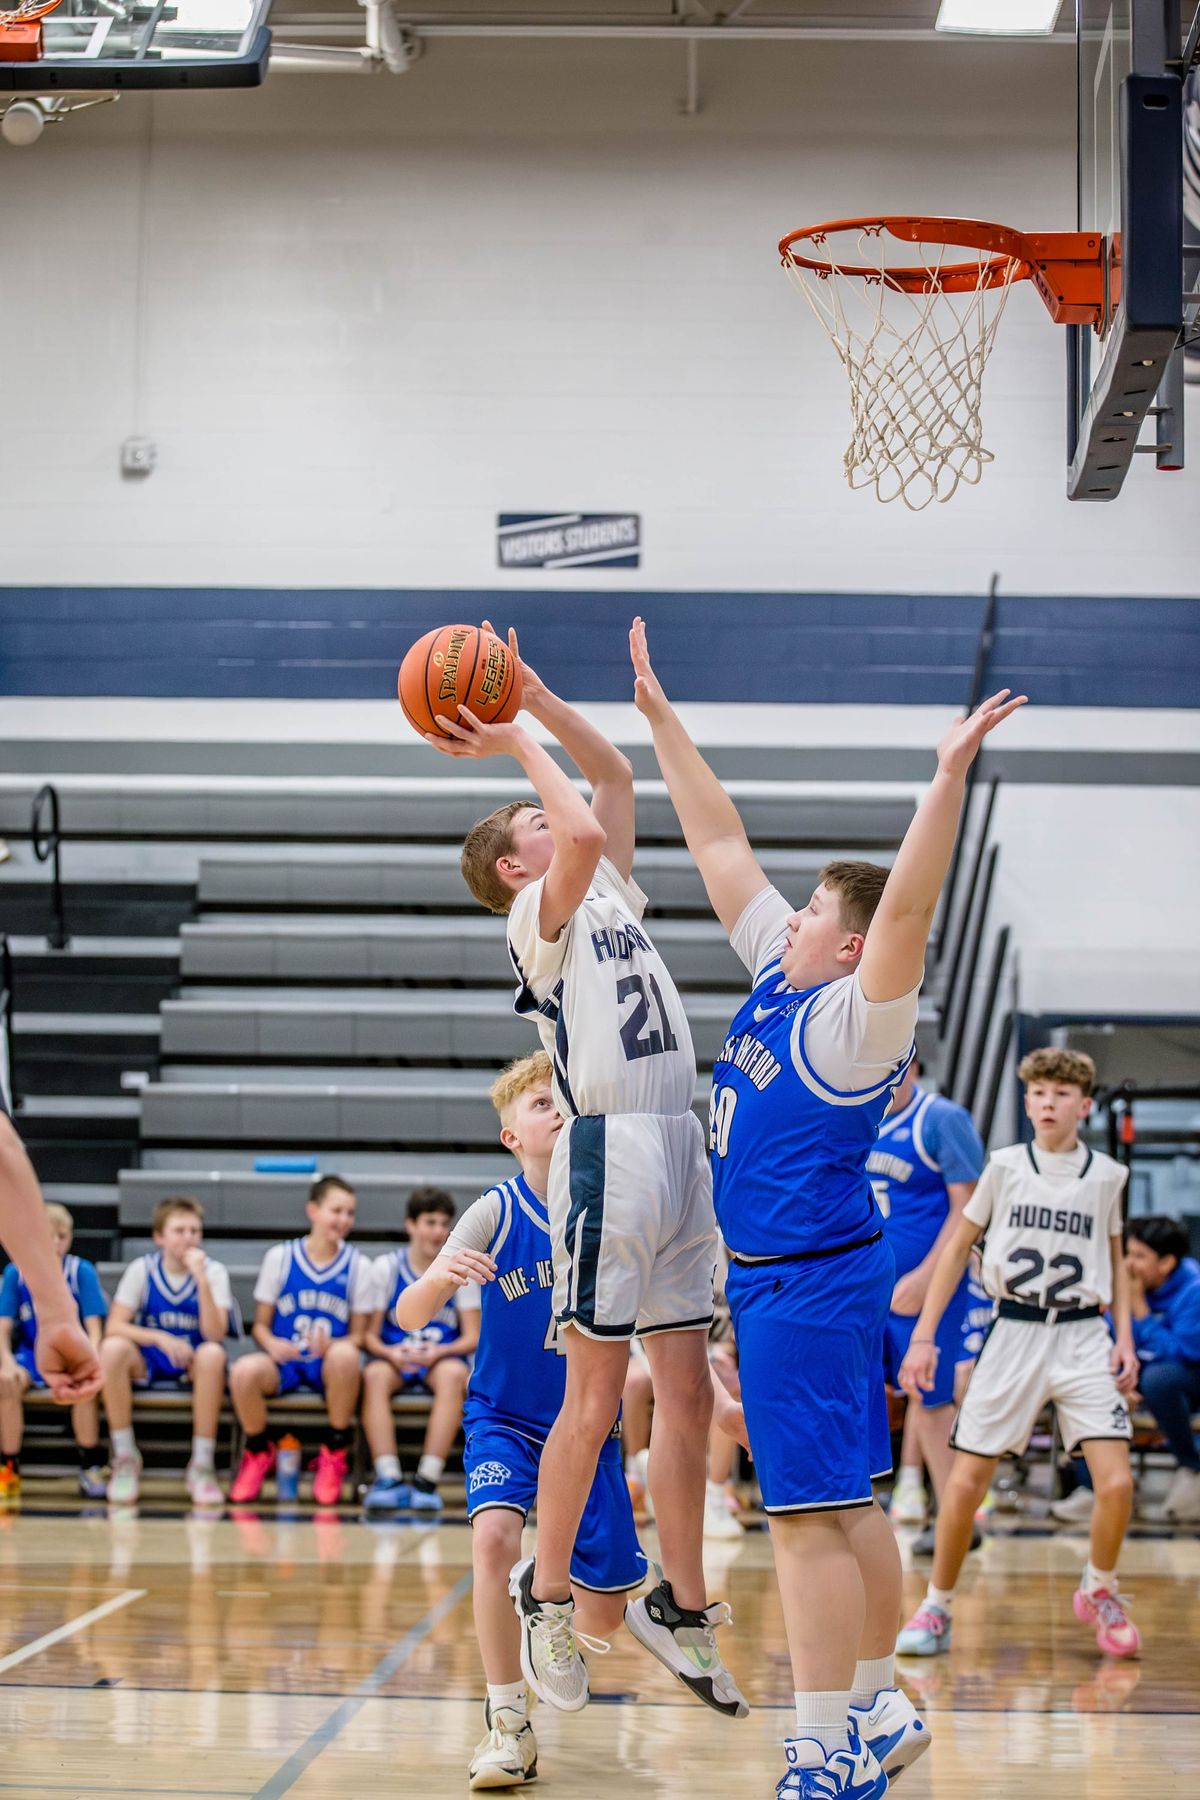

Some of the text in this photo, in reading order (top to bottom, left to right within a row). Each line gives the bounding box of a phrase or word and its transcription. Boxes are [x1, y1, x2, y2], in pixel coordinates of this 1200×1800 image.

[564, 517, 638, 552] STUDENTS
[438, 628, 473, 703] SPALDING
[616, 973, 679, 1062] 21
[1008, 1204, 1094, 1240] HUDSON
[498, 1267, 530, 1302] DIKE
[1005, 1246, 1083, 1311] 22
